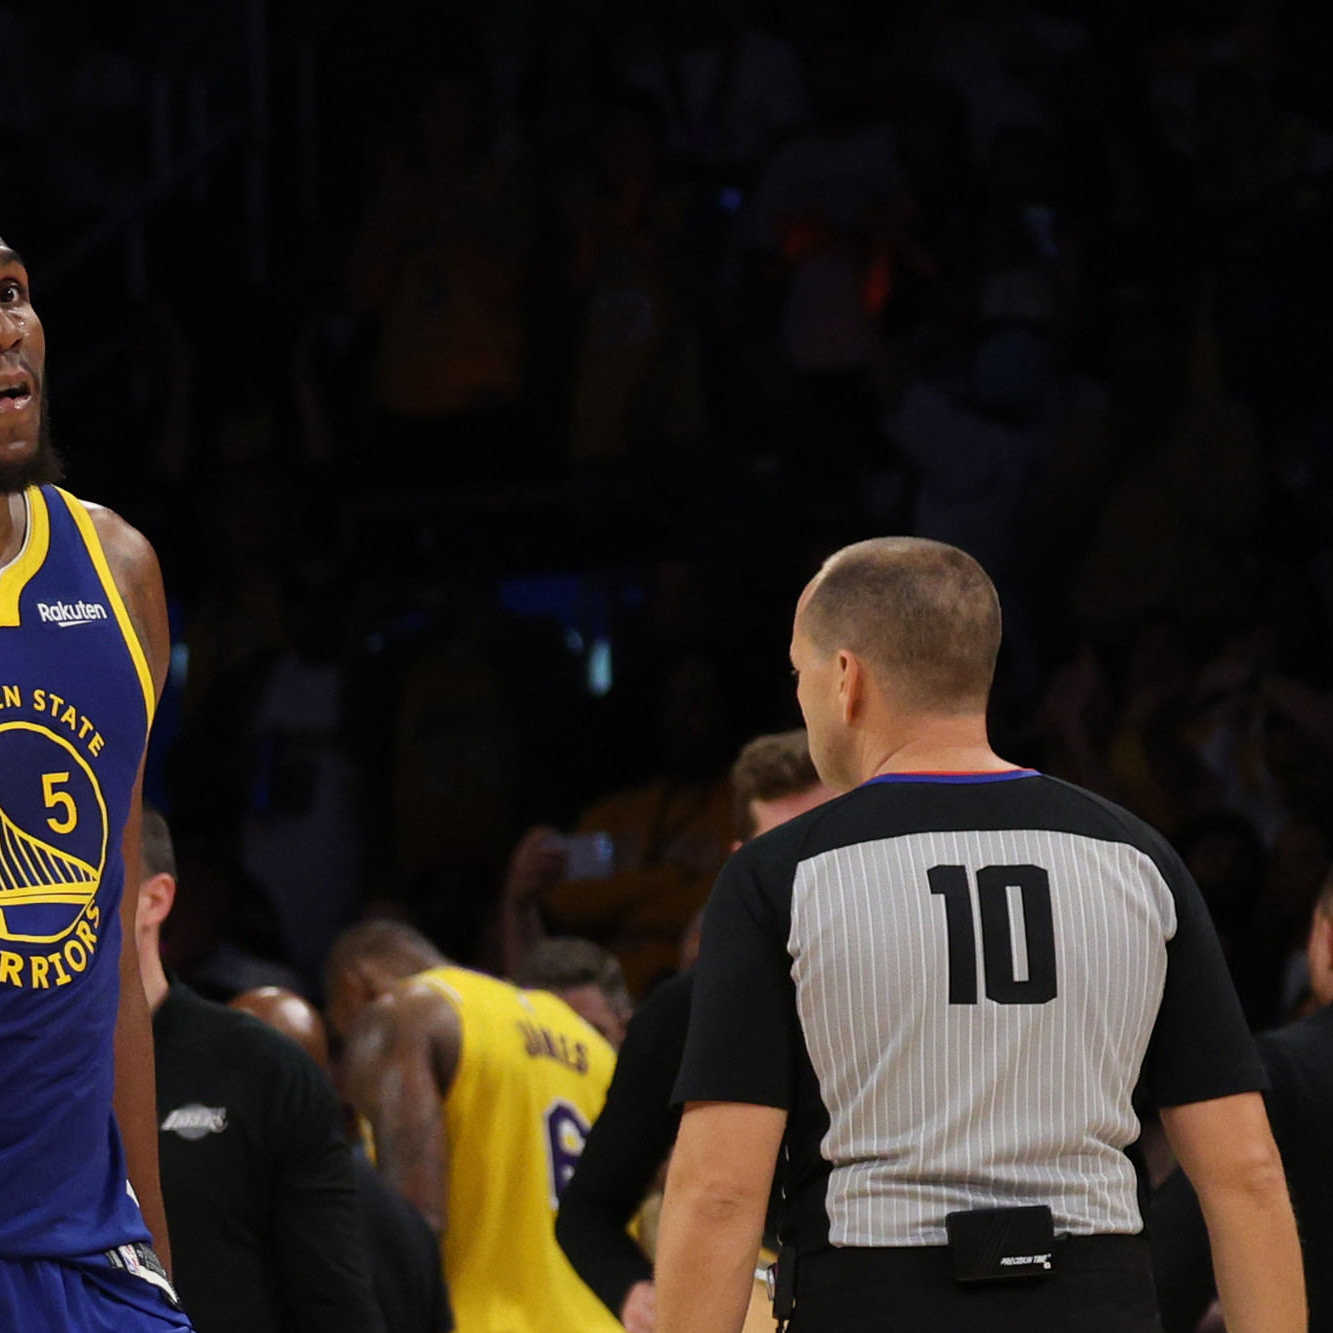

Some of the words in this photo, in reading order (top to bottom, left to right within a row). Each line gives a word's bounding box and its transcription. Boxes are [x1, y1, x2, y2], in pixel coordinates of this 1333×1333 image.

[37, 600, 108, 622] Rakuten
[33, 689, 106, 758] STATE
[42, 771, 78, 834] 5
[927, 863, 1058, 1005] 10
